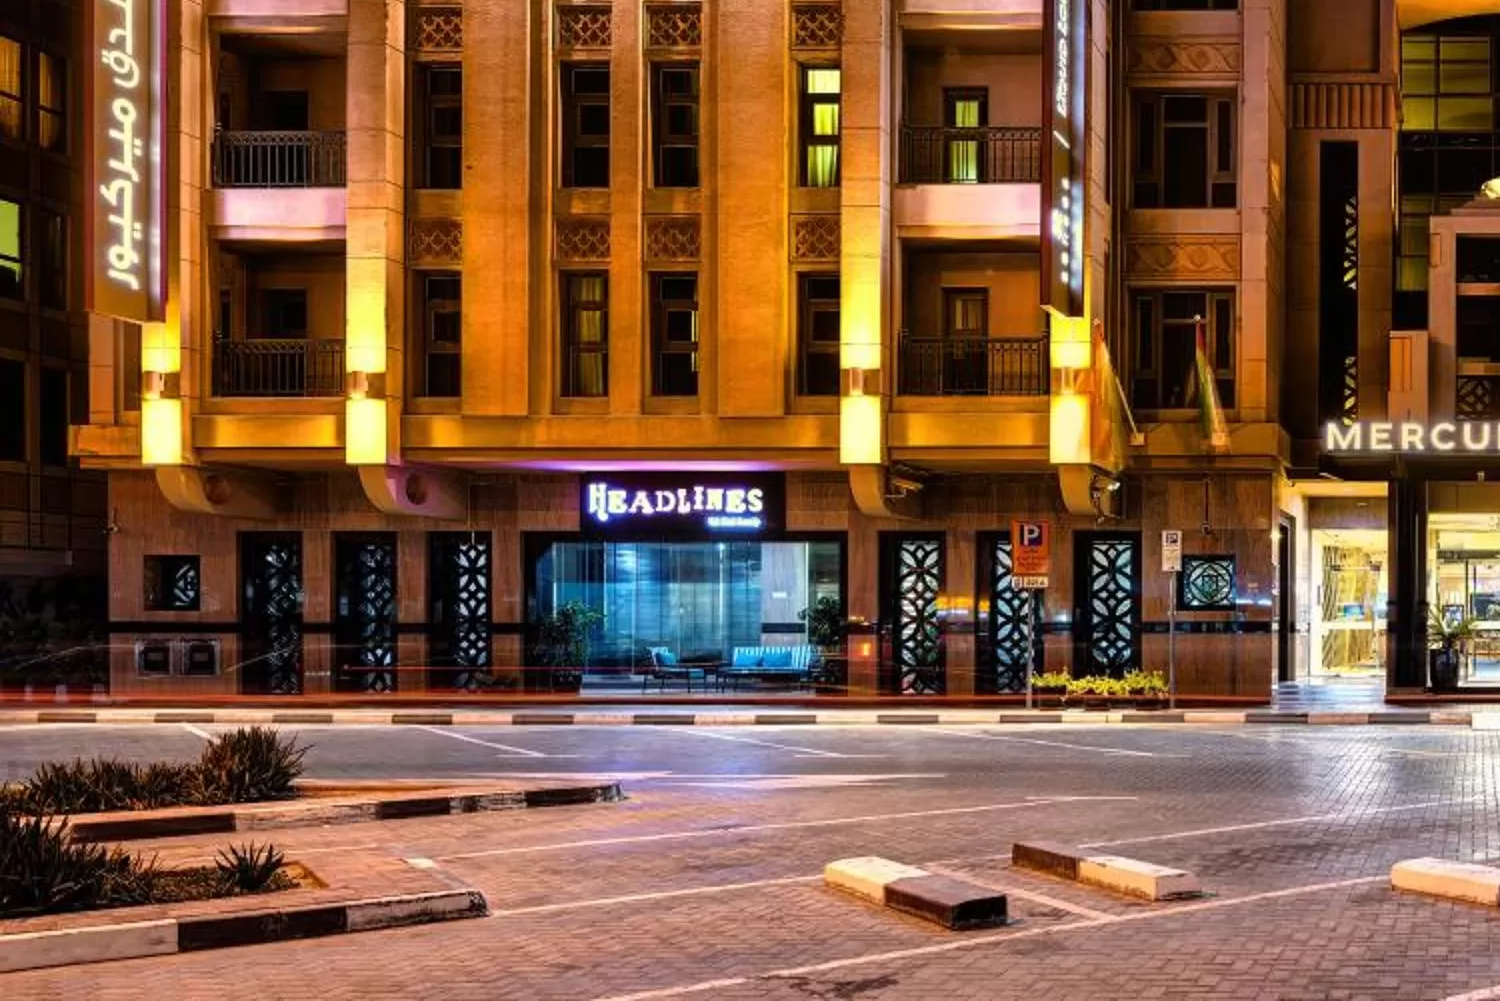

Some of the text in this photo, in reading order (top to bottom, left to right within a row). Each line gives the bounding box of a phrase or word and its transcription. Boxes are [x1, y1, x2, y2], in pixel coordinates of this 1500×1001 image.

[101, 98, 143, 290] ميركيور
[588, 483, 764, 522] HEADLINES
[1023, 523, 1040, 545] P
